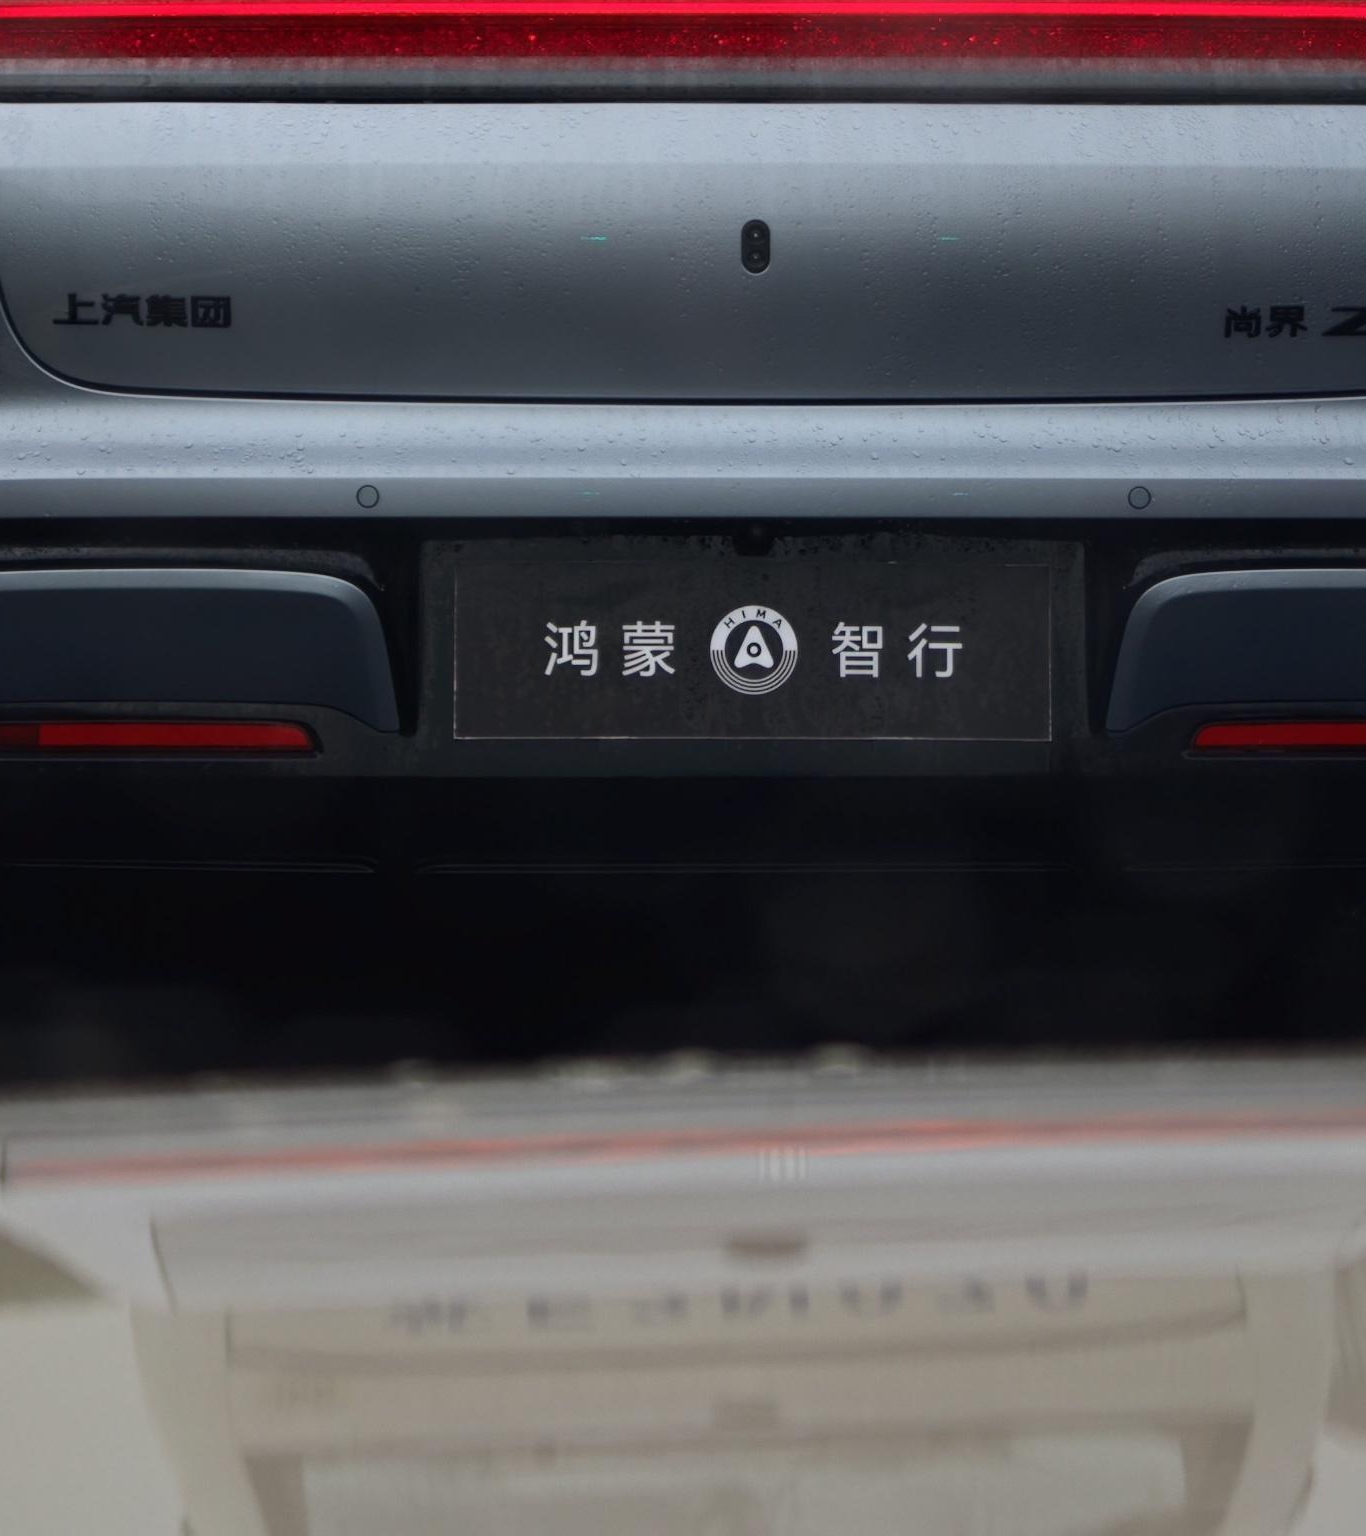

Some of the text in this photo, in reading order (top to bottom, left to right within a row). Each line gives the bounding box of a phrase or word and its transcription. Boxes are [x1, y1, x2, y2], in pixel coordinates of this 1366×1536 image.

[52, 292, 232, 329] 上汽集团
[1223, 304, 1308, 339] 尚界
[722, 607, 785, 630] HIMA
[543, 619, 964, 678] 鸿蒙 智行
